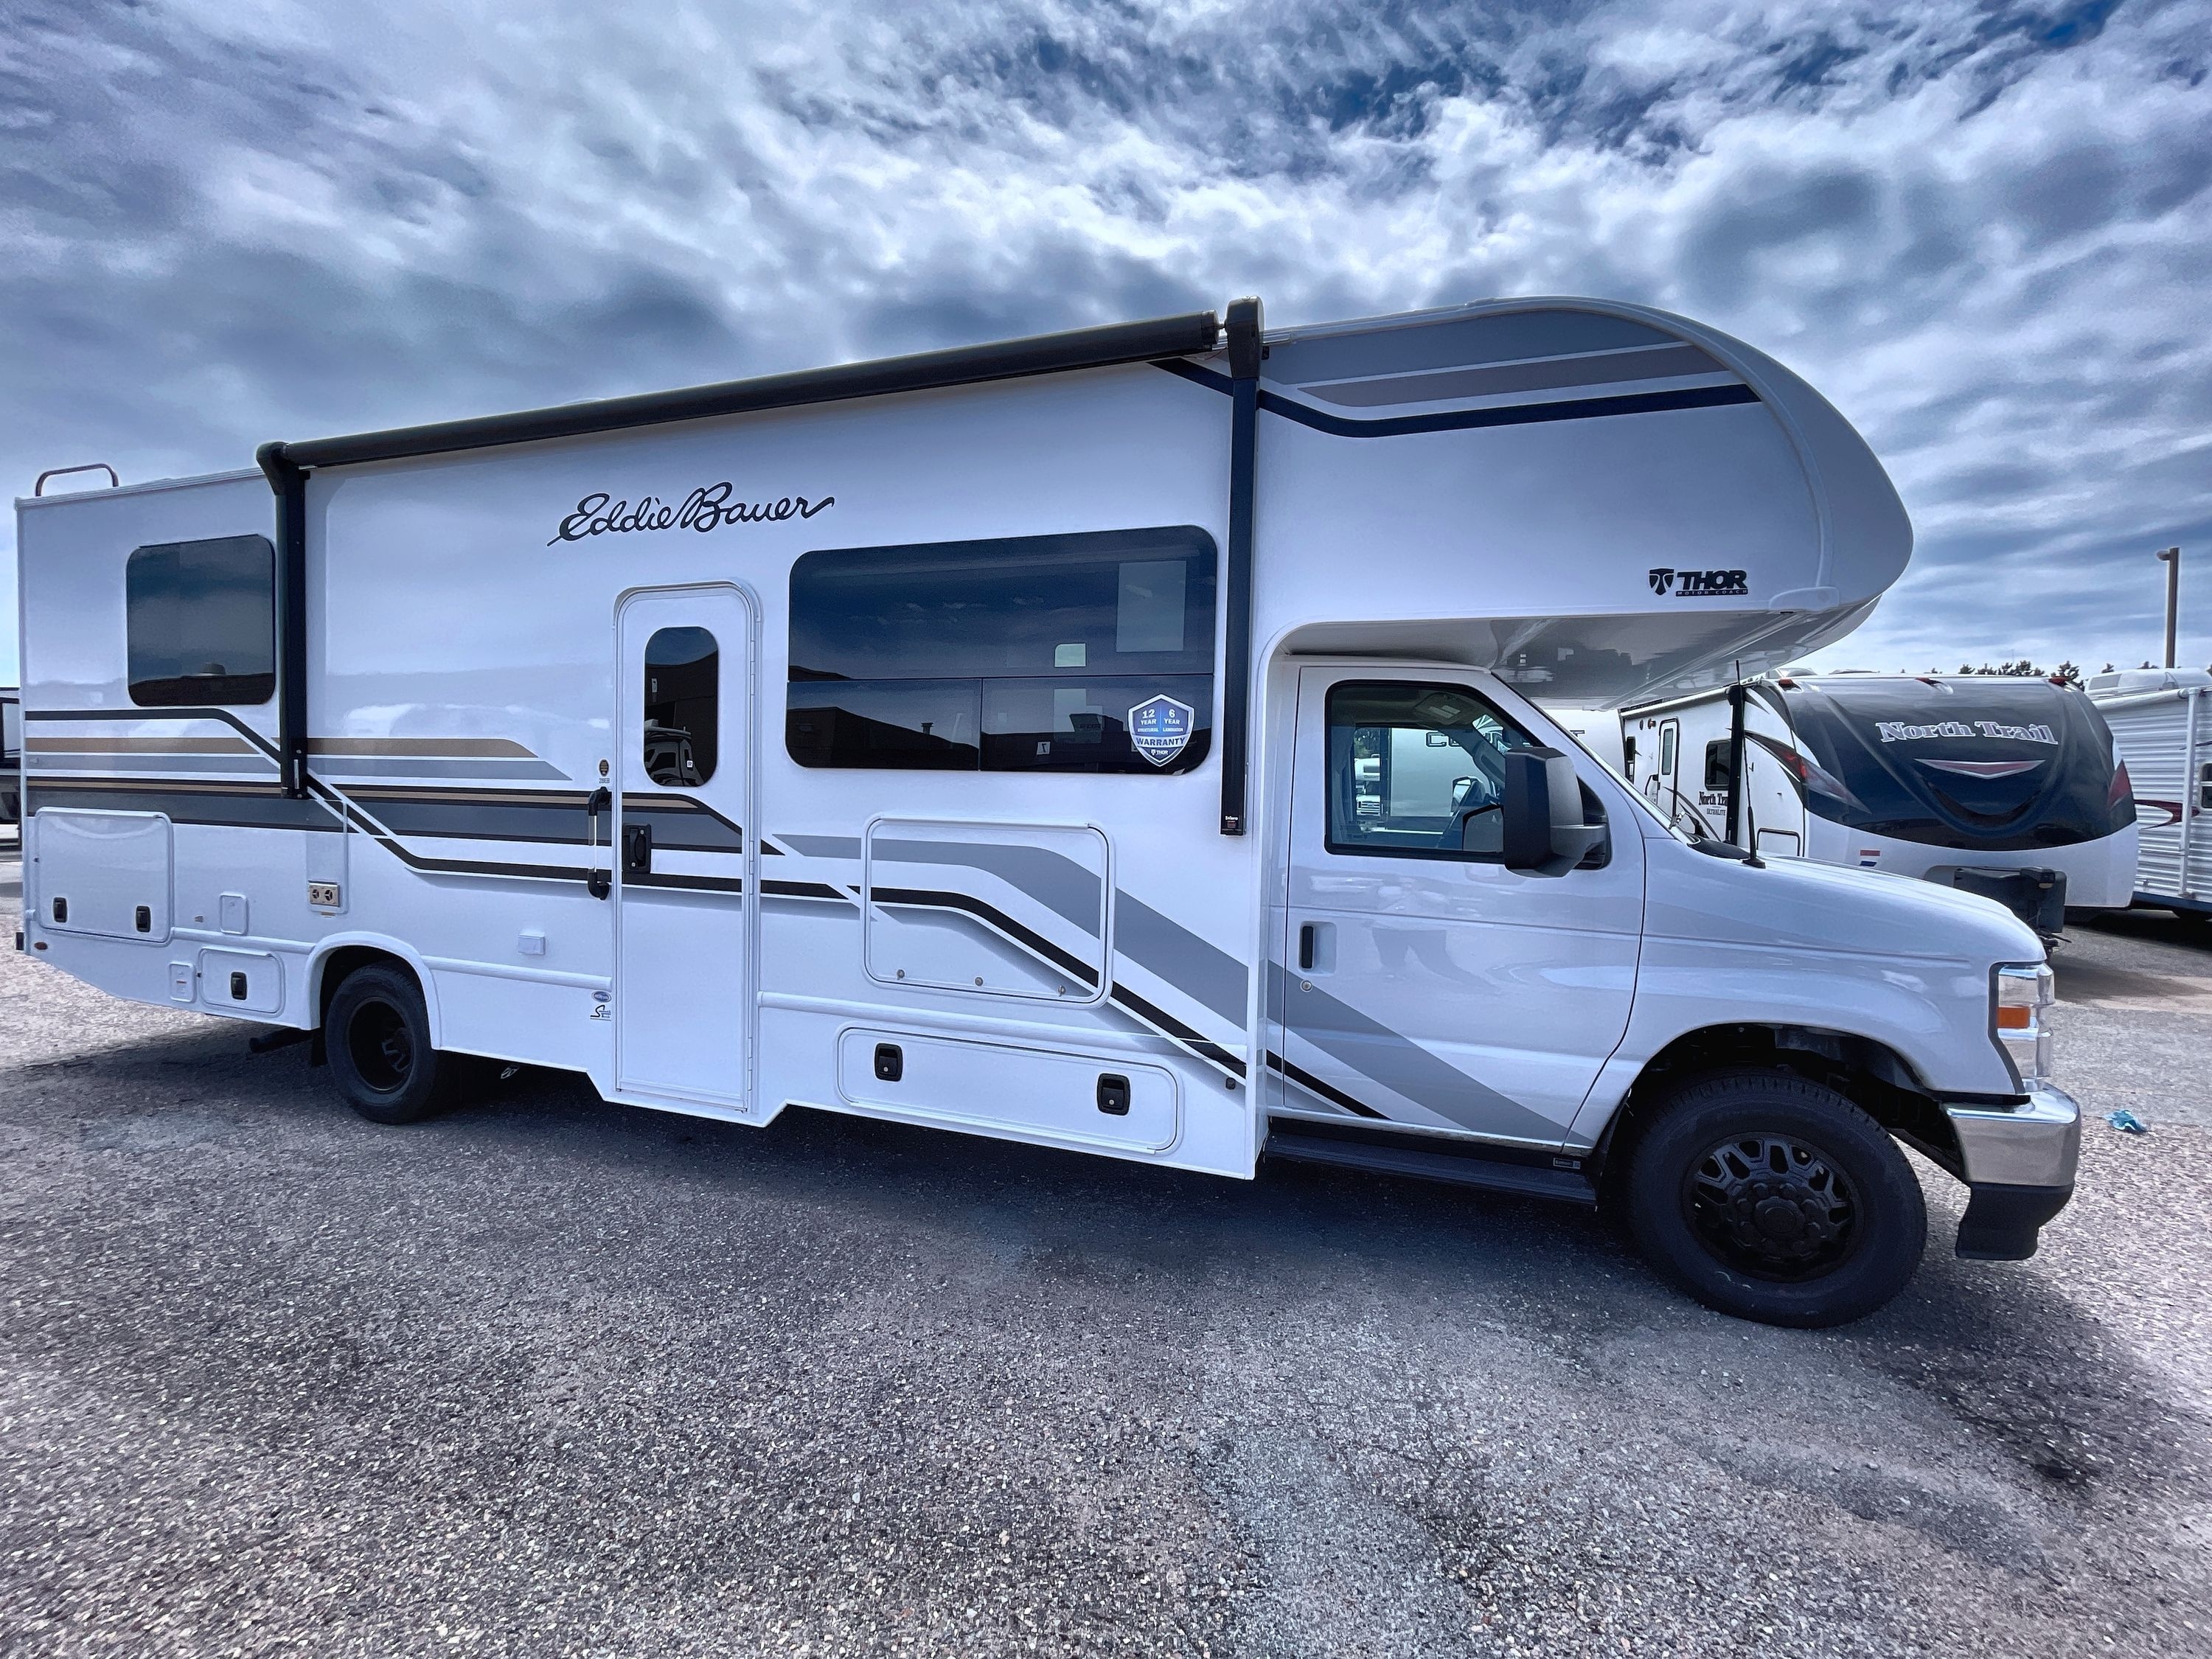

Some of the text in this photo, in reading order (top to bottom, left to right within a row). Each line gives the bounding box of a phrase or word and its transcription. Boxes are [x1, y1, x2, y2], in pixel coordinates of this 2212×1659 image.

[546, 481, 835, 547] Eddie Bauer
[1677, 570, 1747, 591] THOR
[1142, 709, 1155, 719] 12
[1169, 709, 1175, 717] 6
[1875, 721, 2059, 745] North Trail
[1135, 737, 1186, 746] WARRANTY
[1699, 791, 1728, 806] North Tra
